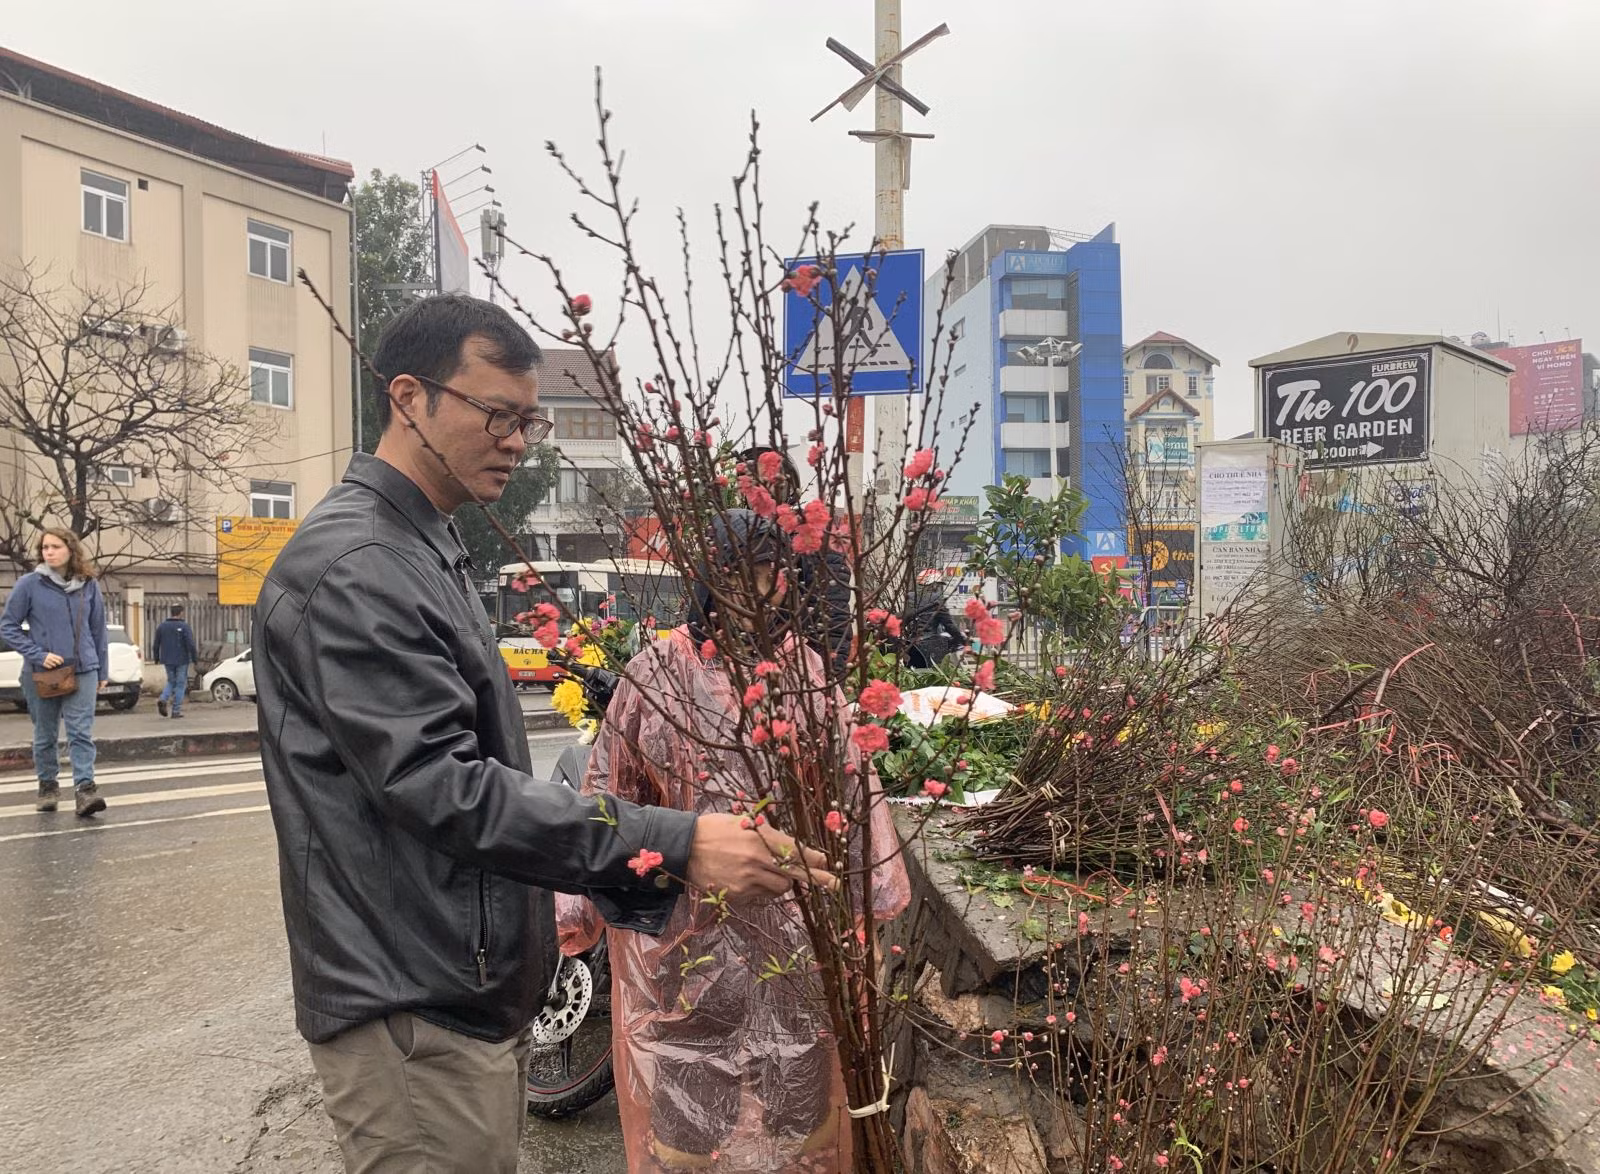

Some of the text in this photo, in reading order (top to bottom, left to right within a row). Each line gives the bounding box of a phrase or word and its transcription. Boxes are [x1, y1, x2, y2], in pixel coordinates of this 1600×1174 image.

[1371, 360, 1418, 373] FURBREW
[1546, 361, 1572, 369] MOMO
[1276, 375, 1417, 426] The 100
[1280, 418, 1413, 444] BEER GARDEN
[1172, 549, 1194, 561] the
